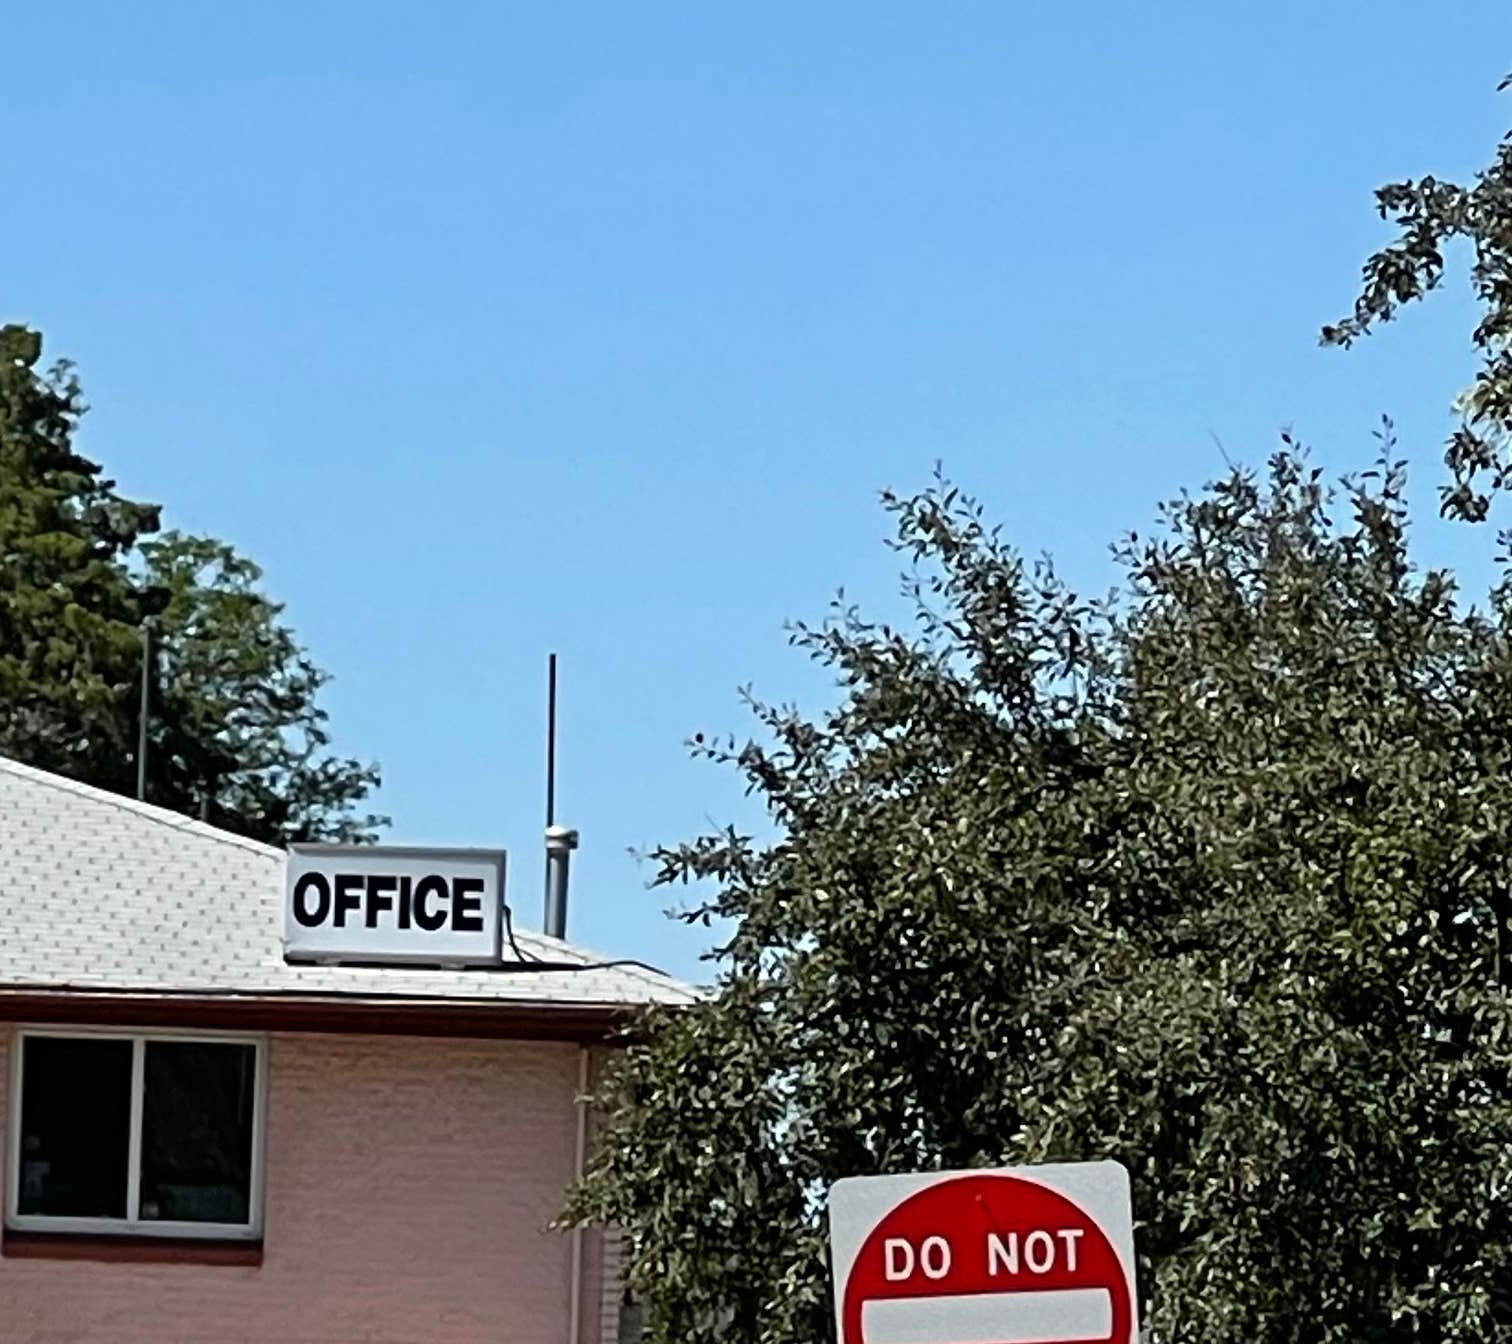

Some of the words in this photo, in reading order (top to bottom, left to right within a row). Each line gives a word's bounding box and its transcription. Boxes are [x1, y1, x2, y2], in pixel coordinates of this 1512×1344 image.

[293, 871, 484, 932] OFFICE
[884, 1236, 952, 1281] DO
[988, 1229, 1084, 1275] NOT
